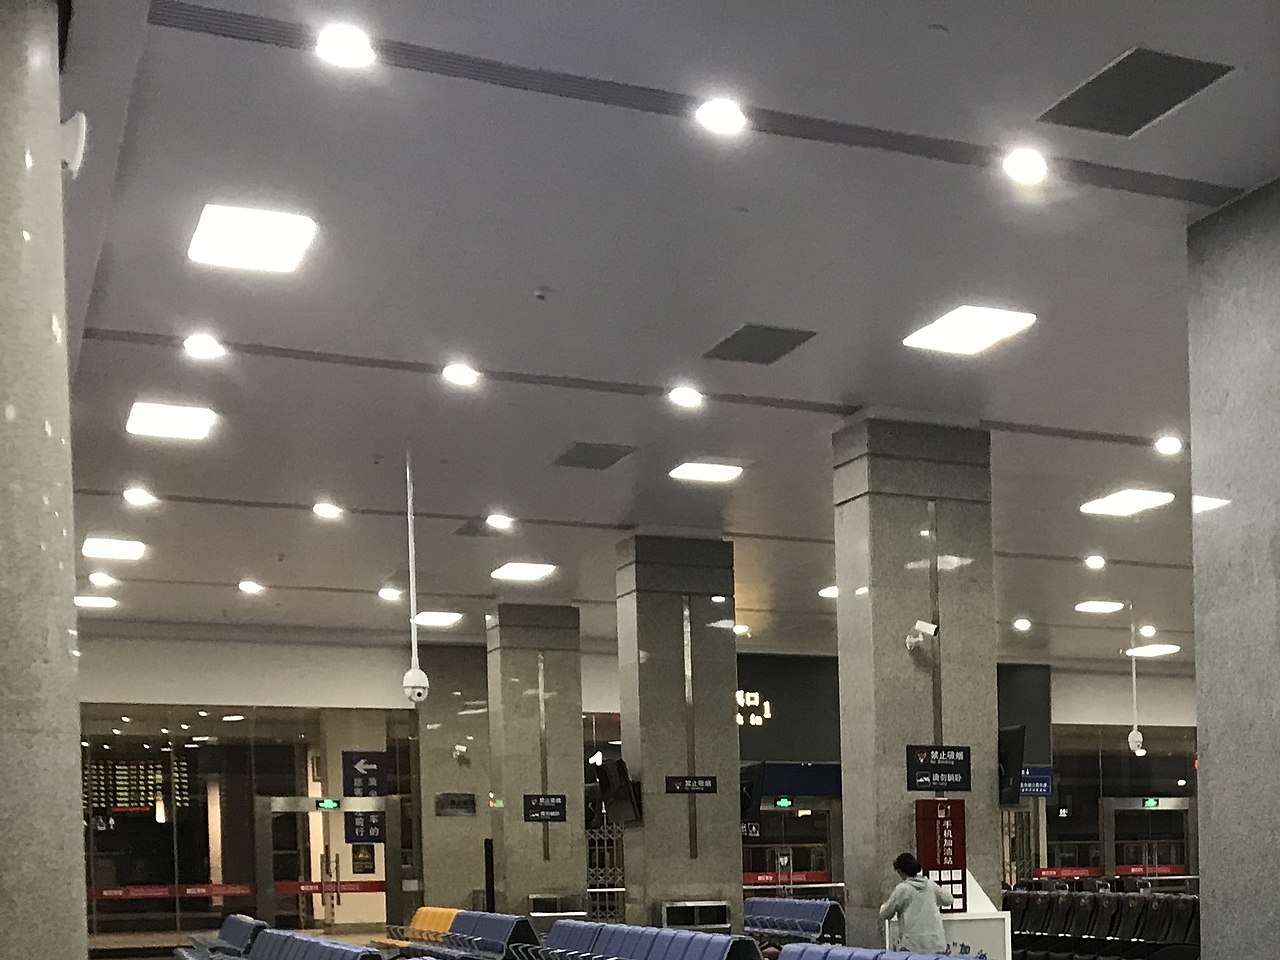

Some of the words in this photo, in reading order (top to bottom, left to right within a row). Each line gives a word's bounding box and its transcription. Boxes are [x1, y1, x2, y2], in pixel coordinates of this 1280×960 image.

[930, 750, 964, 760] 禁止吸烟
[942, 819, 954, 865] 手机加油站
